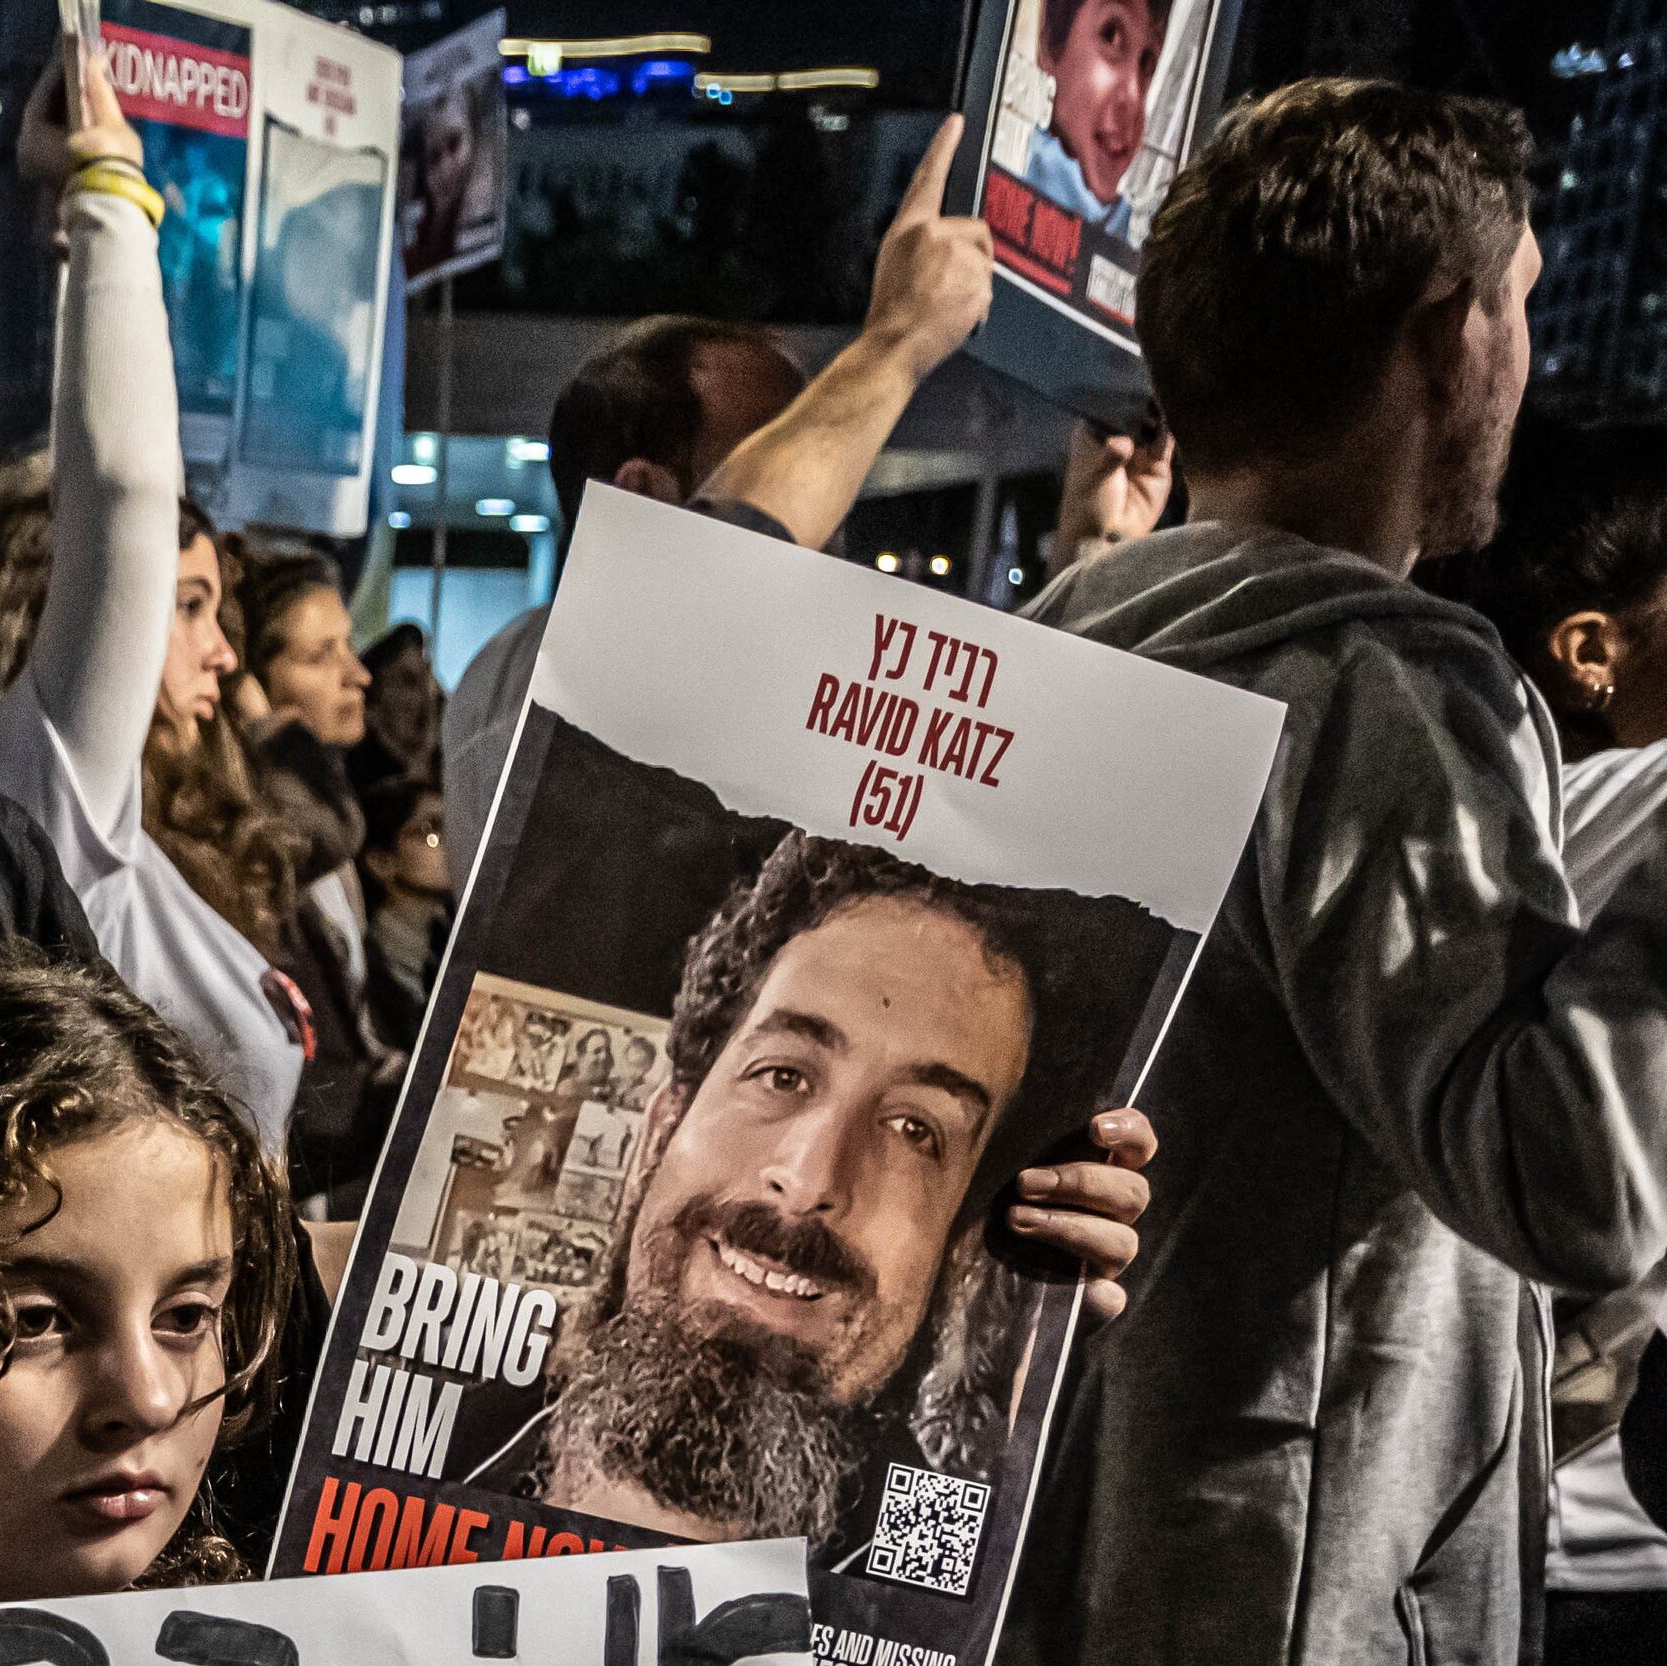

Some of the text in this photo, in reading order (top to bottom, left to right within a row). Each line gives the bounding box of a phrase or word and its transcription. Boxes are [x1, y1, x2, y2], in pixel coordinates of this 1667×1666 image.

[101, 37, 248, 119] KIDNAPPED
[922, 630, 999, 709] רביד
[805, 672, 1016, 788] RAVID KATZ
[849, 759, 925, 842] (51)
[358, 1251, 558, 1388] BRING
[331, 1357, 464, 1480] HIM
[833, 1629, 874, 1666] AND
